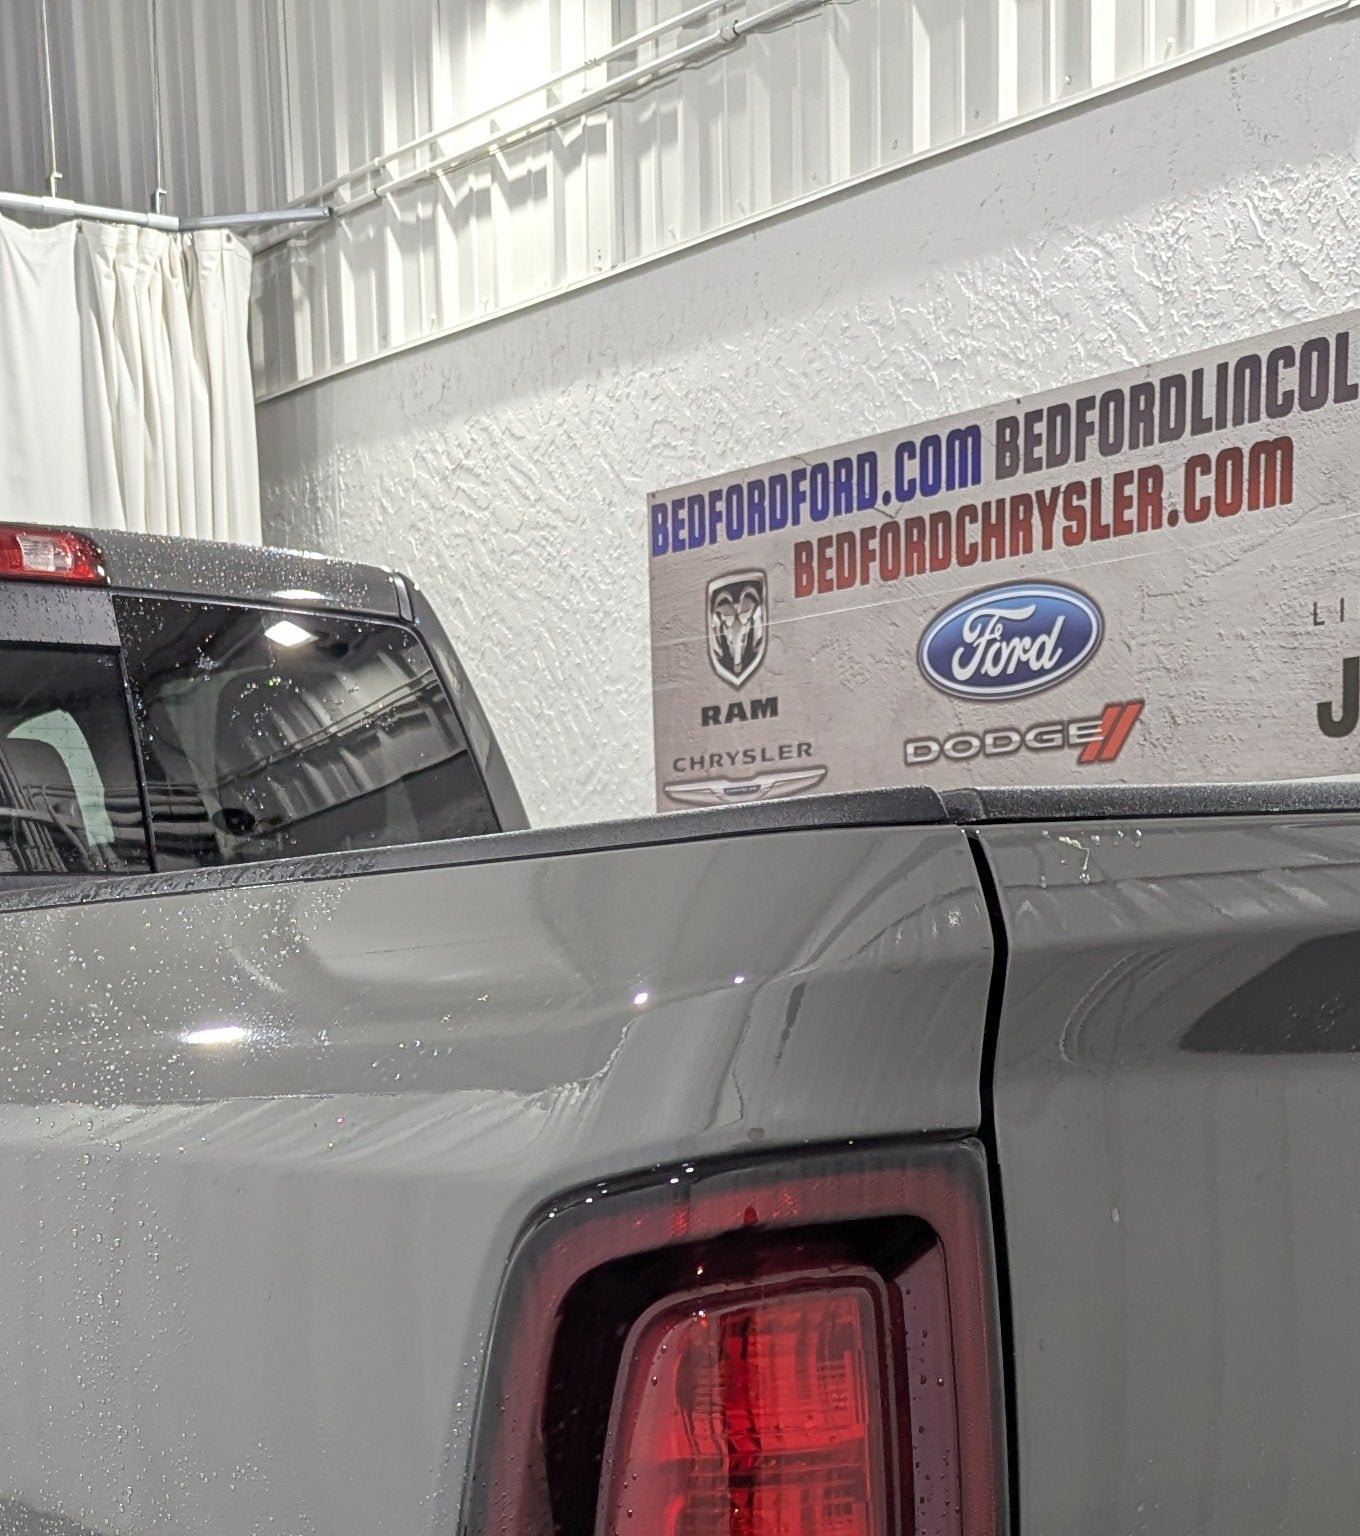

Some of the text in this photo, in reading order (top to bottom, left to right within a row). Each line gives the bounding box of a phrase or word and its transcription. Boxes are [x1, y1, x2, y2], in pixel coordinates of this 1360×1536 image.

[650, 424, 982, 558] BEDFORDFORD.COM
[794, 435, 1295, 599] BEDFORDCHRYSLER.COM
[951, 604, 1067, 681] Ford
[701, 696, 779, 728] RAM
[905, 717, 1106, 767] DODGE
[672, 742, 814, 773] CHRYSLER
